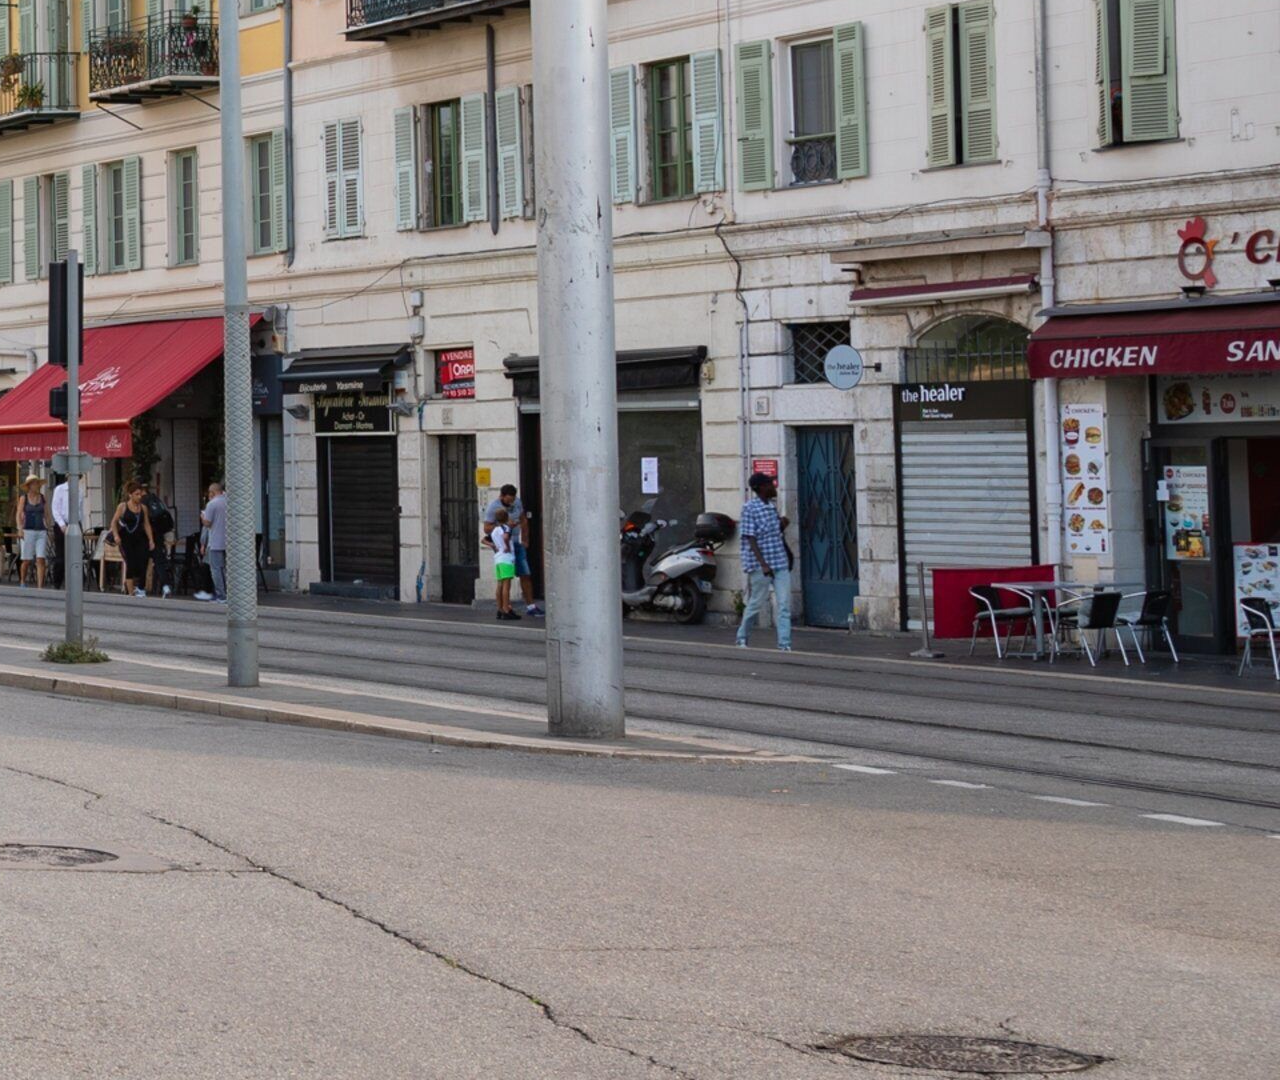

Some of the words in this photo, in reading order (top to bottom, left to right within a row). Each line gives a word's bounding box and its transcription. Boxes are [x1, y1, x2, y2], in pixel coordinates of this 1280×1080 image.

[1049, 345, 1158, 368] CHICKEN
[836, 362, 859, 370] healer
[299, 383, 328, 393] Bijouterie
[336, 381, 364, 390] Yasmine
[901, 389, 918, 403] the
[919, 383, 966, 402] healer
